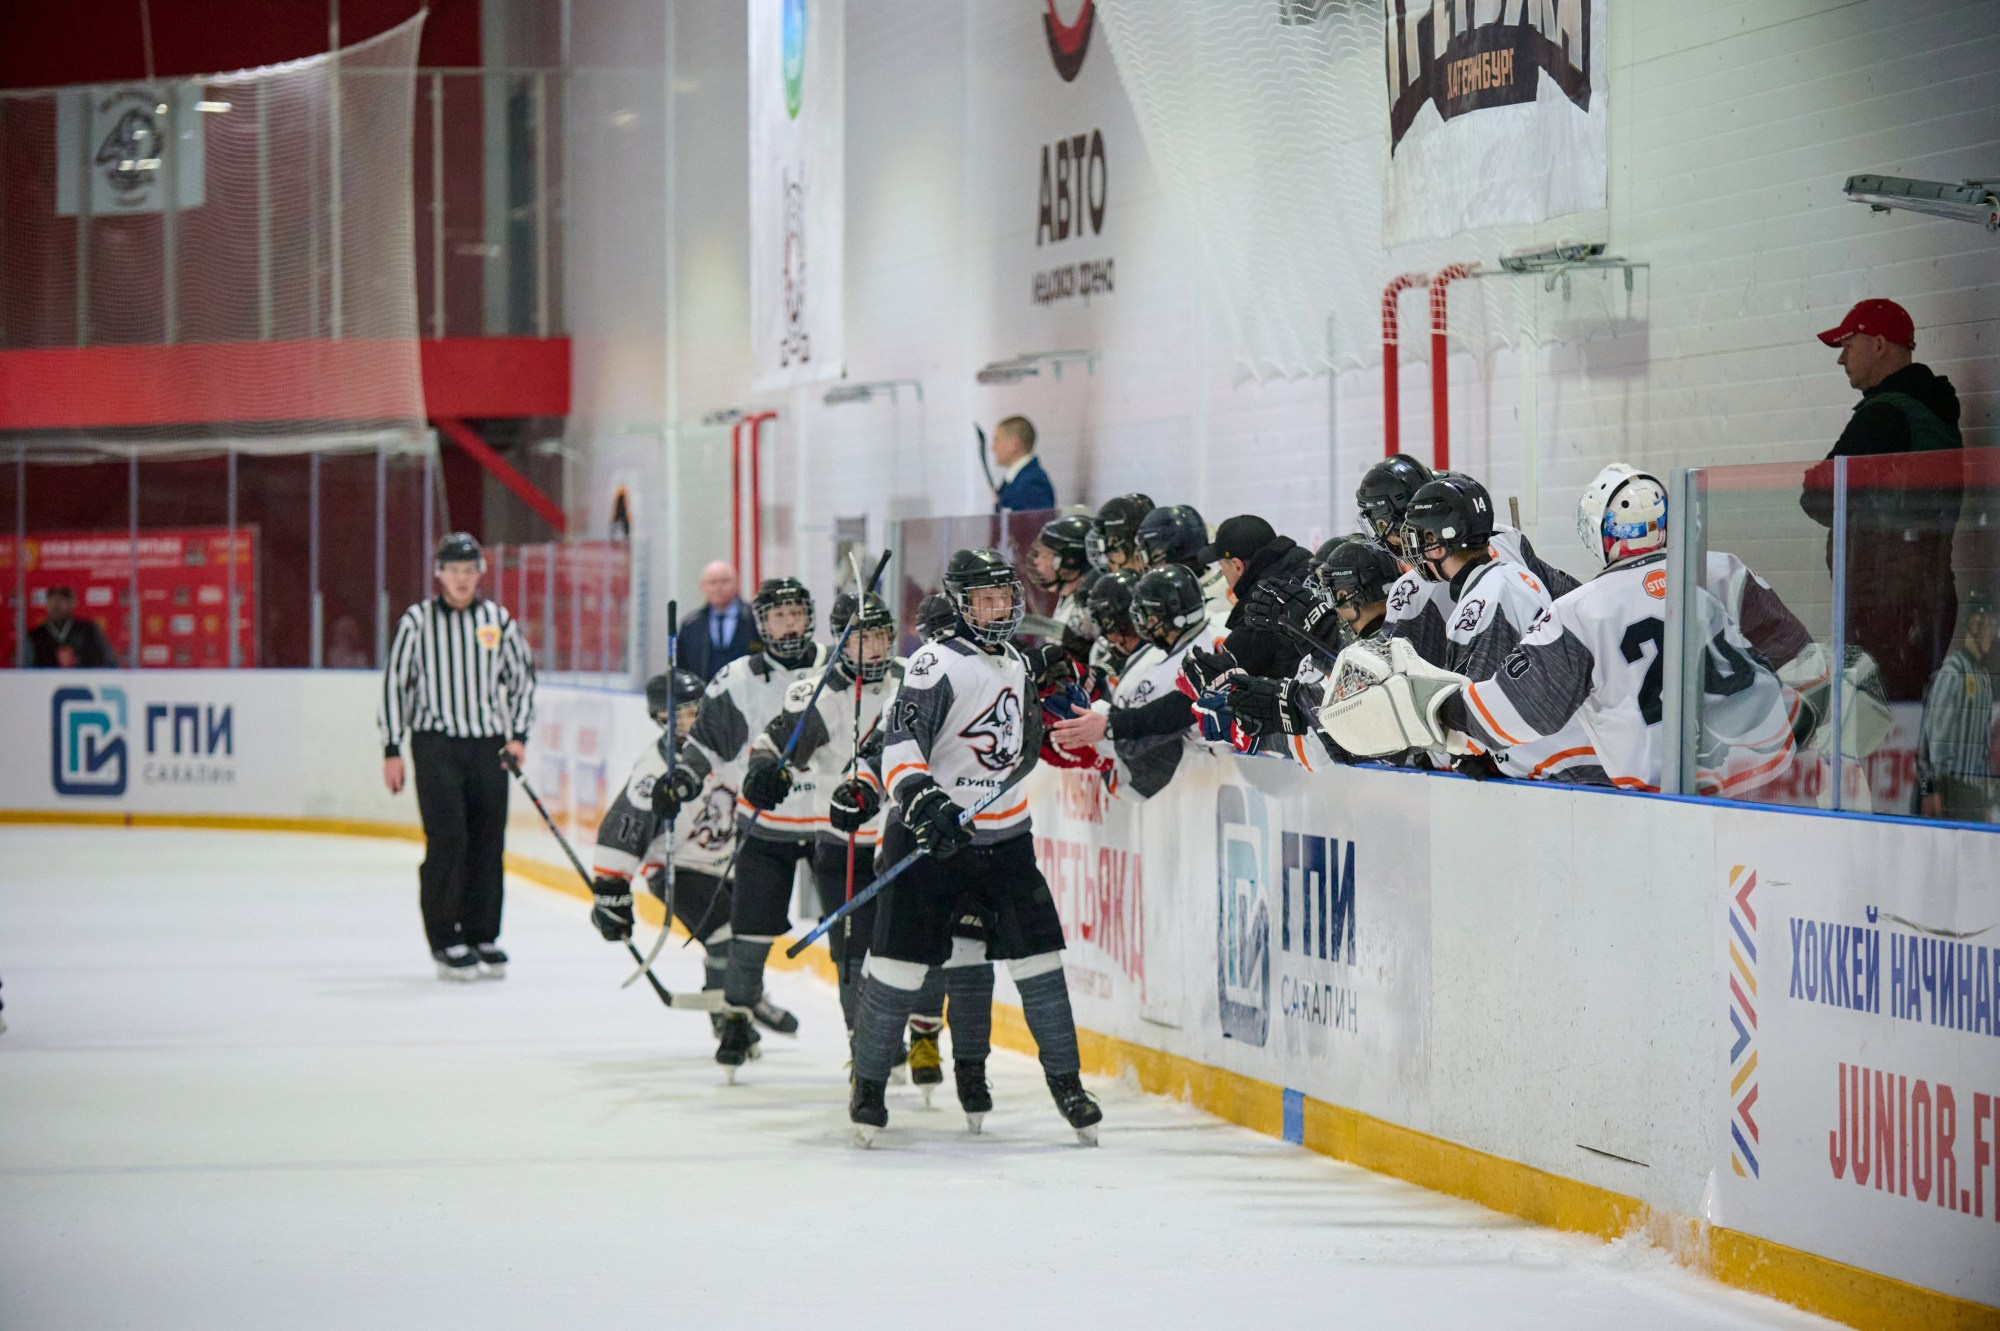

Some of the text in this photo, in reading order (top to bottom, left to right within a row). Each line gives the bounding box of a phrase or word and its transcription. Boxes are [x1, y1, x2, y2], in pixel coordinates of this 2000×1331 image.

[1037, 127, 1106, 247] АВТО
[1473, 496, 1487, 514] 14
[1646, 578, 1667, 593] STO
[146, 705, 233, 755] ГПИ
[893, 699, 919, 734] 12
[1278, 677, 1293, 734] TRUE
[1281, 830, 1357, 967] ГПИ
[1789, 905, 1880, 1015] ХОККЕЙ
[1281, 974, 1358, 1035] САХАЛИН
